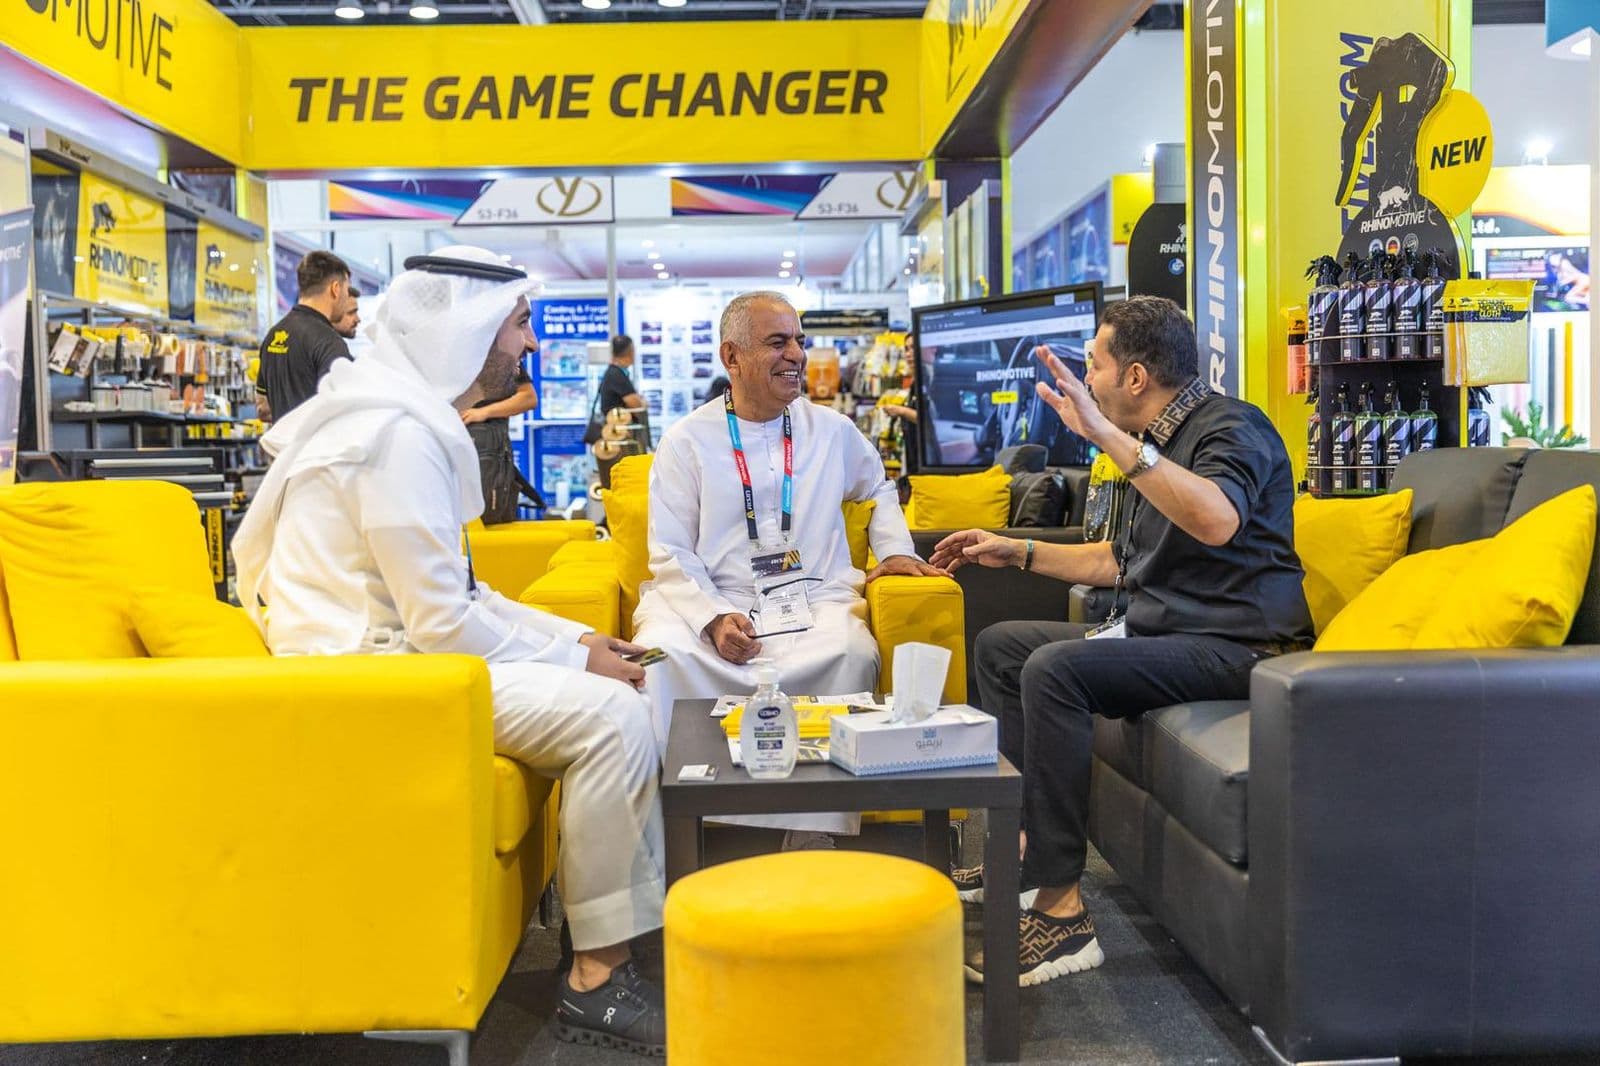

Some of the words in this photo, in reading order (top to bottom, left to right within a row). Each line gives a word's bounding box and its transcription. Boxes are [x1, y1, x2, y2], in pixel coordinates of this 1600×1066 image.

[289, 77, 408, 123] THE
[424, 73, 594, 122] GAME
[609, 69, 889, 119] CHANGER
[1430, 135, 1487, 171] NEW
[1360, 210, 1425, 234] RHINOMOTIVE
[1160, 242, 1186, 254] RHIN
[976, 367, 1035, 382] RHINOMOTIVE
